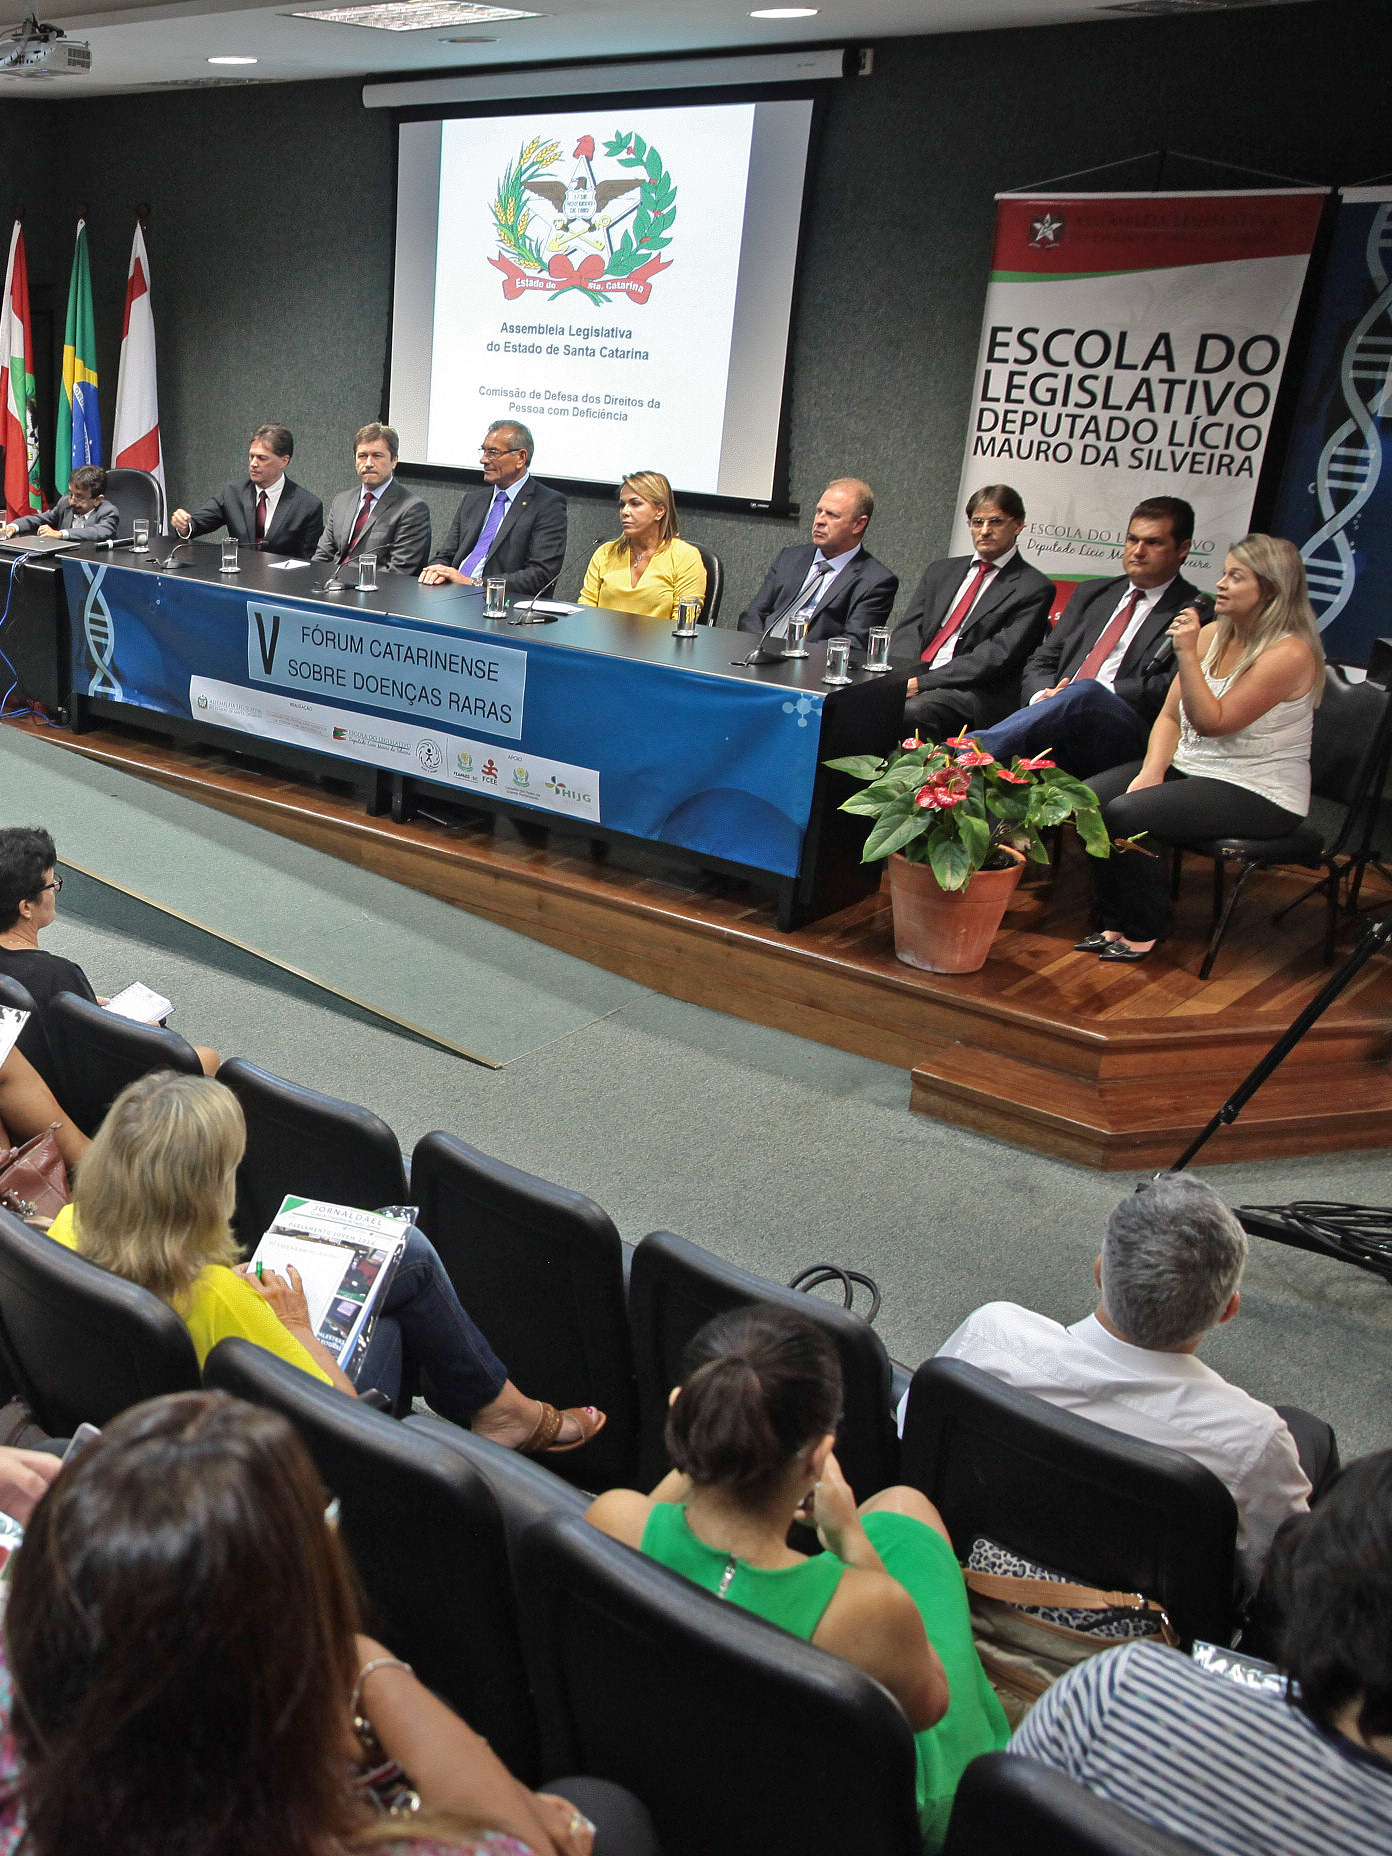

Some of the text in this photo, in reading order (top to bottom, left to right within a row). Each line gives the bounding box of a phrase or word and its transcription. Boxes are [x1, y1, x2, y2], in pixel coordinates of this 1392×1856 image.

[516, 278, 544, 289] Estado
[606, 282, 644, 293] Catarina
[500, 322, 632, 340] Assembleia Legislativa
[486, 340, 650, 361] do Estado de Santa Catarina
[986, 326, 1281, 377] ESCOLA DO
[478, 385, 661, 409] Comissão de Defesa dos Direitos da
[980, 369, 1272, 419] LEGISLATIVO
[508, 402, 628, 422] Pessoa com Deficiência
[976, 407, 1263, 452] DEPUTADO LÍCIO
[973, 436, 1254, 479] MAURO DA SILVEIRA
[1030, 522, 1082, 539] ESCOLA
[1087, 529, 1112, 542] DO
[1026, 538, 1076, 556] Deputado
[1079, 544, 1105, 558] Lício
[1182, 558, 1212, 570] veira
[254, 612, 500, 683] V FÓRUM CATARINENSE
[288, 659, 512, 724] SOBRE DOENÇAS RARAS
[482, 776, 498, 786] FCEE
[319, 1332, 345, 1344] ALESTRAS
